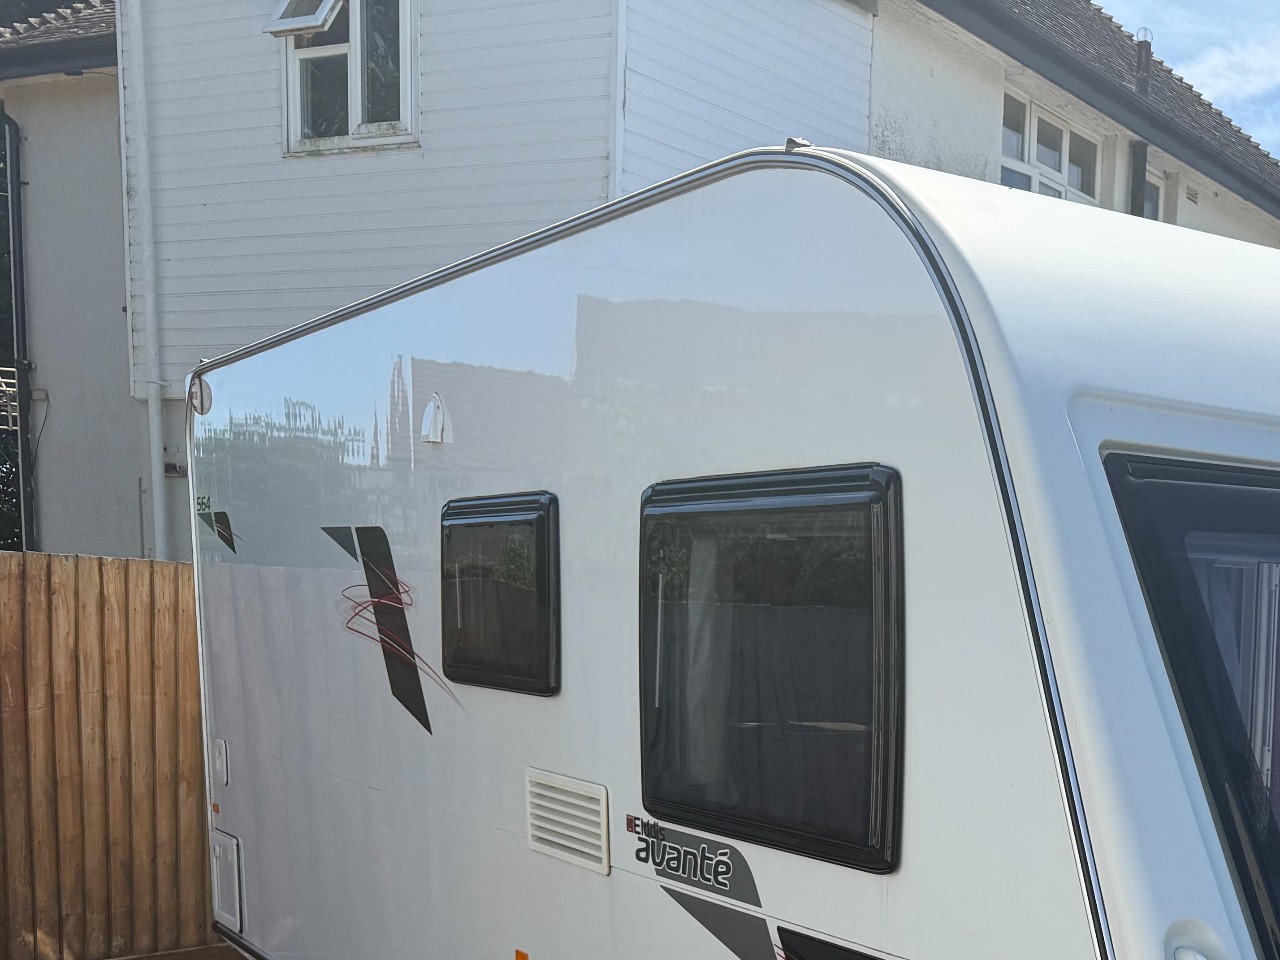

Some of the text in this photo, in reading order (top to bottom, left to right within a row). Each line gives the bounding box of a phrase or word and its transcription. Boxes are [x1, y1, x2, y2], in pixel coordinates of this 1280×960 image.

[196, 496, 211, 512] 564
[633, 817, 666, 842] Elddis
[635, 836, 733, 890] avanté
